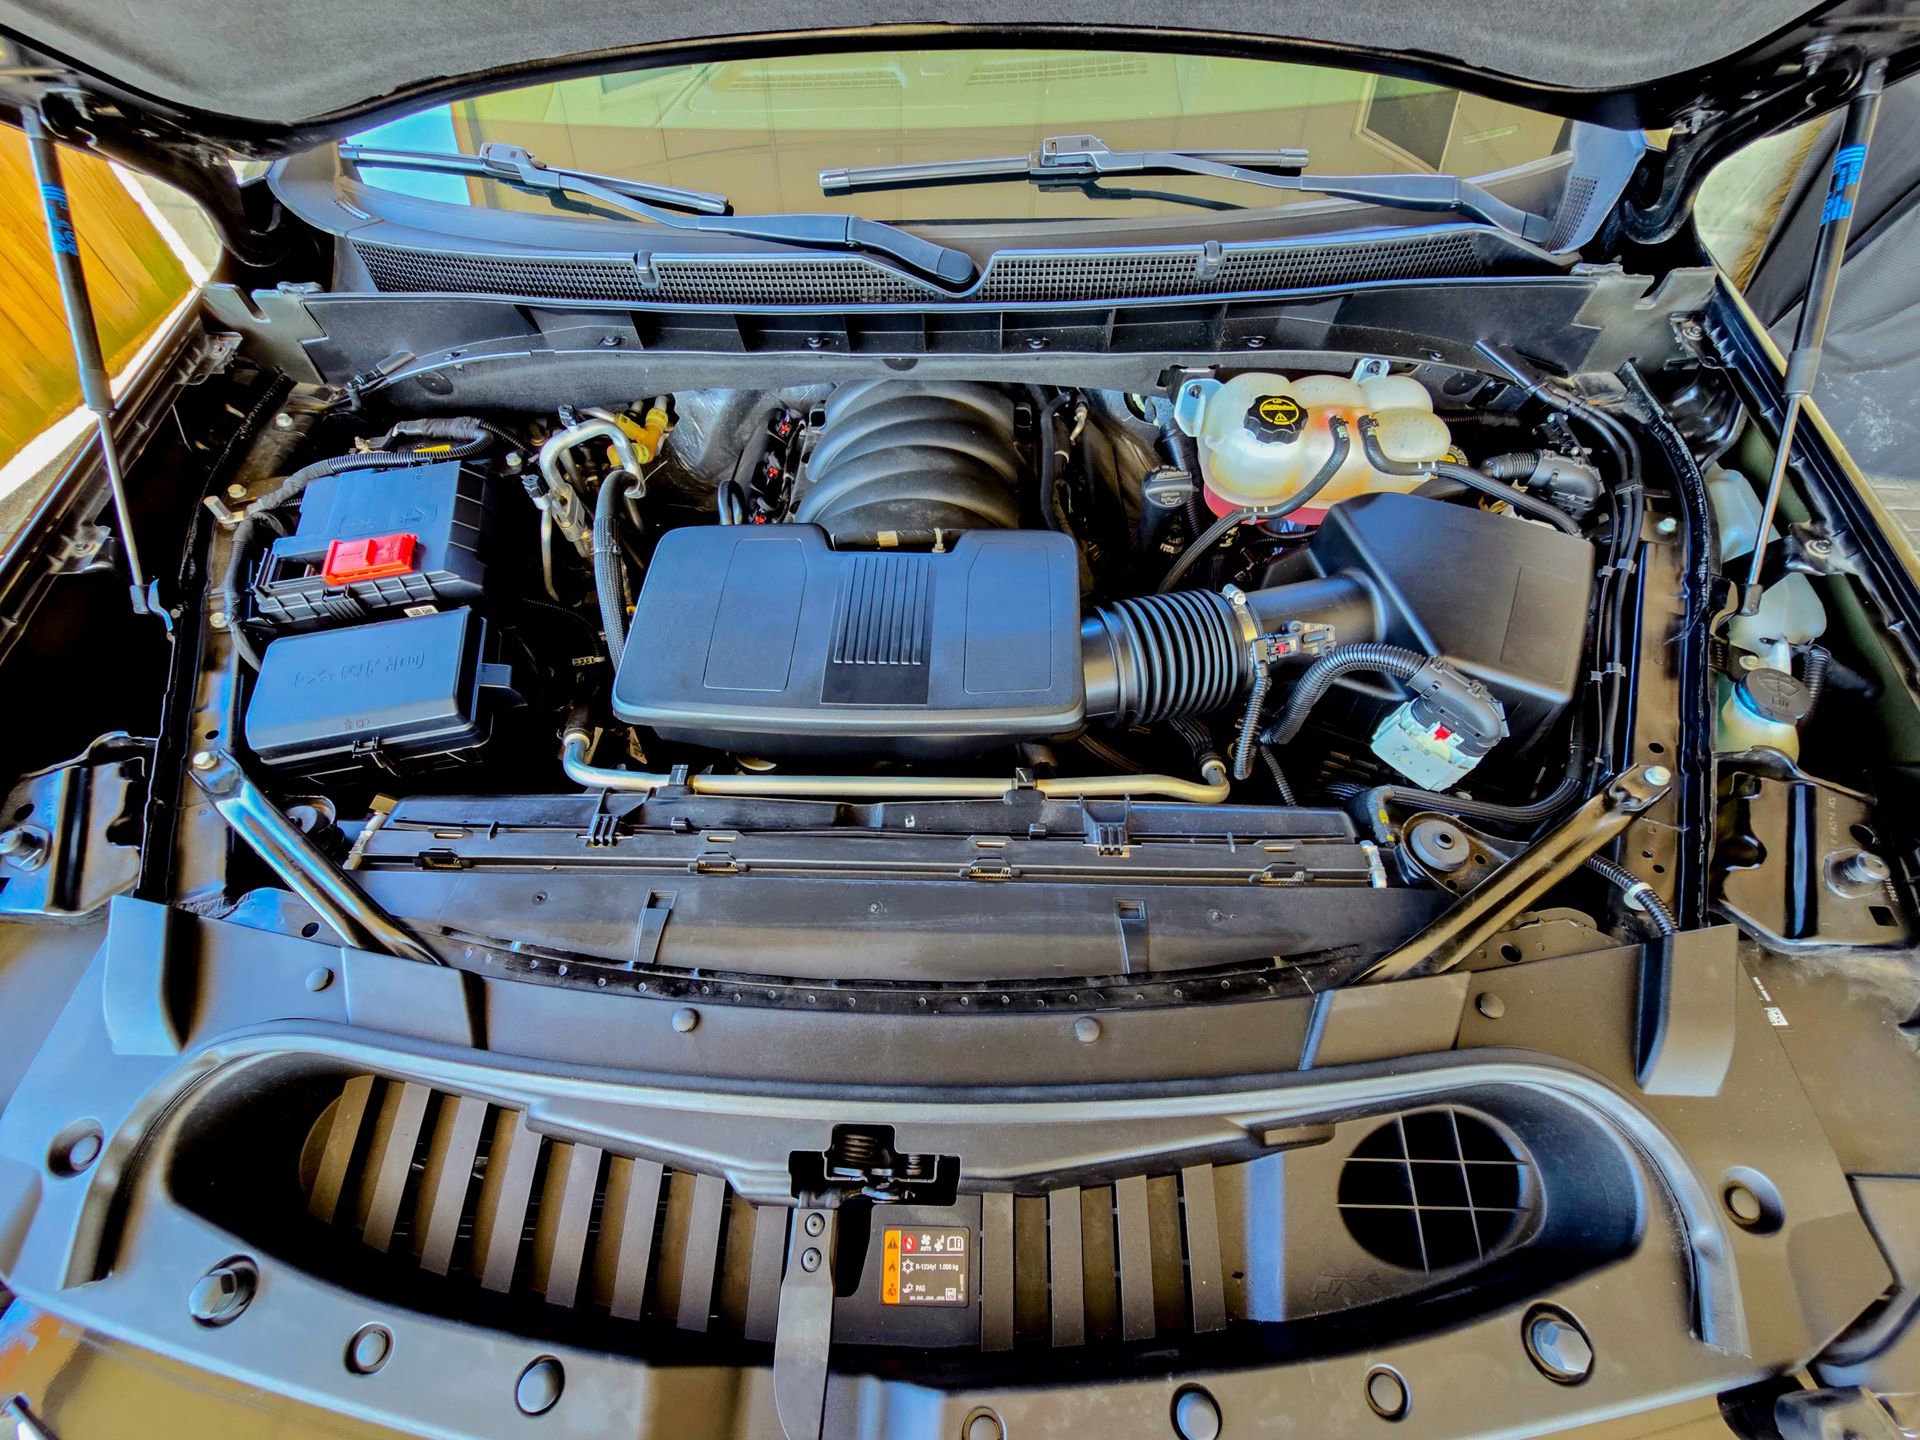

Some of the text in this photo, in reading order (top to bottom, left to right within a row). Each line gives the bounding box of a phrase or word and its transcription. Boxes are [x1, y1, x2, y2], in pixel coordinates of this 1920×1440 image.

[915, 1263, 937, 1272] R-1234yf
[952, 1263, 959, 1272] kg
[915, 1284, 926, 1292] PAG
